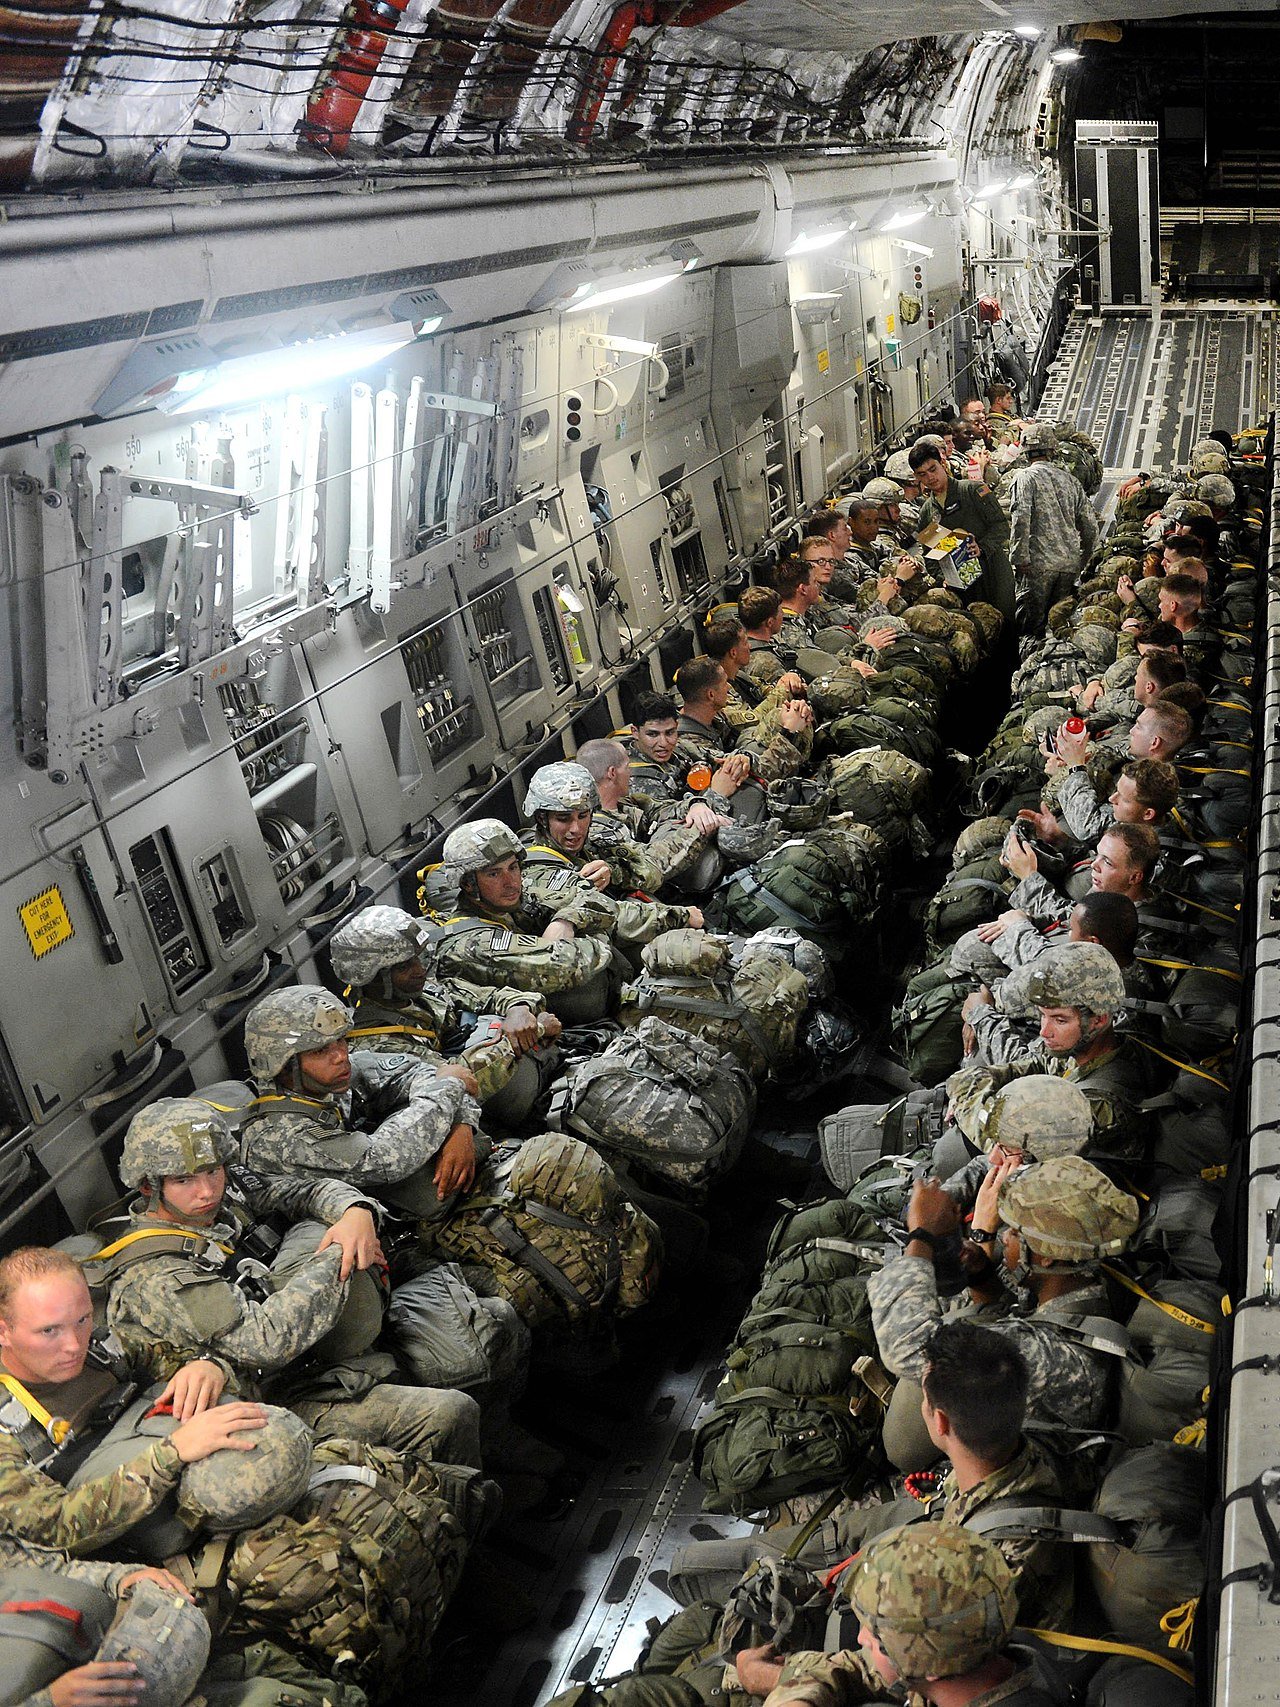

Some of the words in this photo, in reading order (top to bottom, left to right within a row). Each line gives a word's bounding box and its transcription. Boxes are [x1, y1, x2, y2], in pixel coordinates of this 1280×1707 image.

[125, 438, 141, 458] 550
[176, 440, 190, 459] 560
[28, 906, 40, 918] CUT
[40, 896, 54, 911] HERE
[39, 910, 51, 923] FOR
[33, 915, 63, 940] EMERGENCY
[45, 930, 59, 944] EXIT
